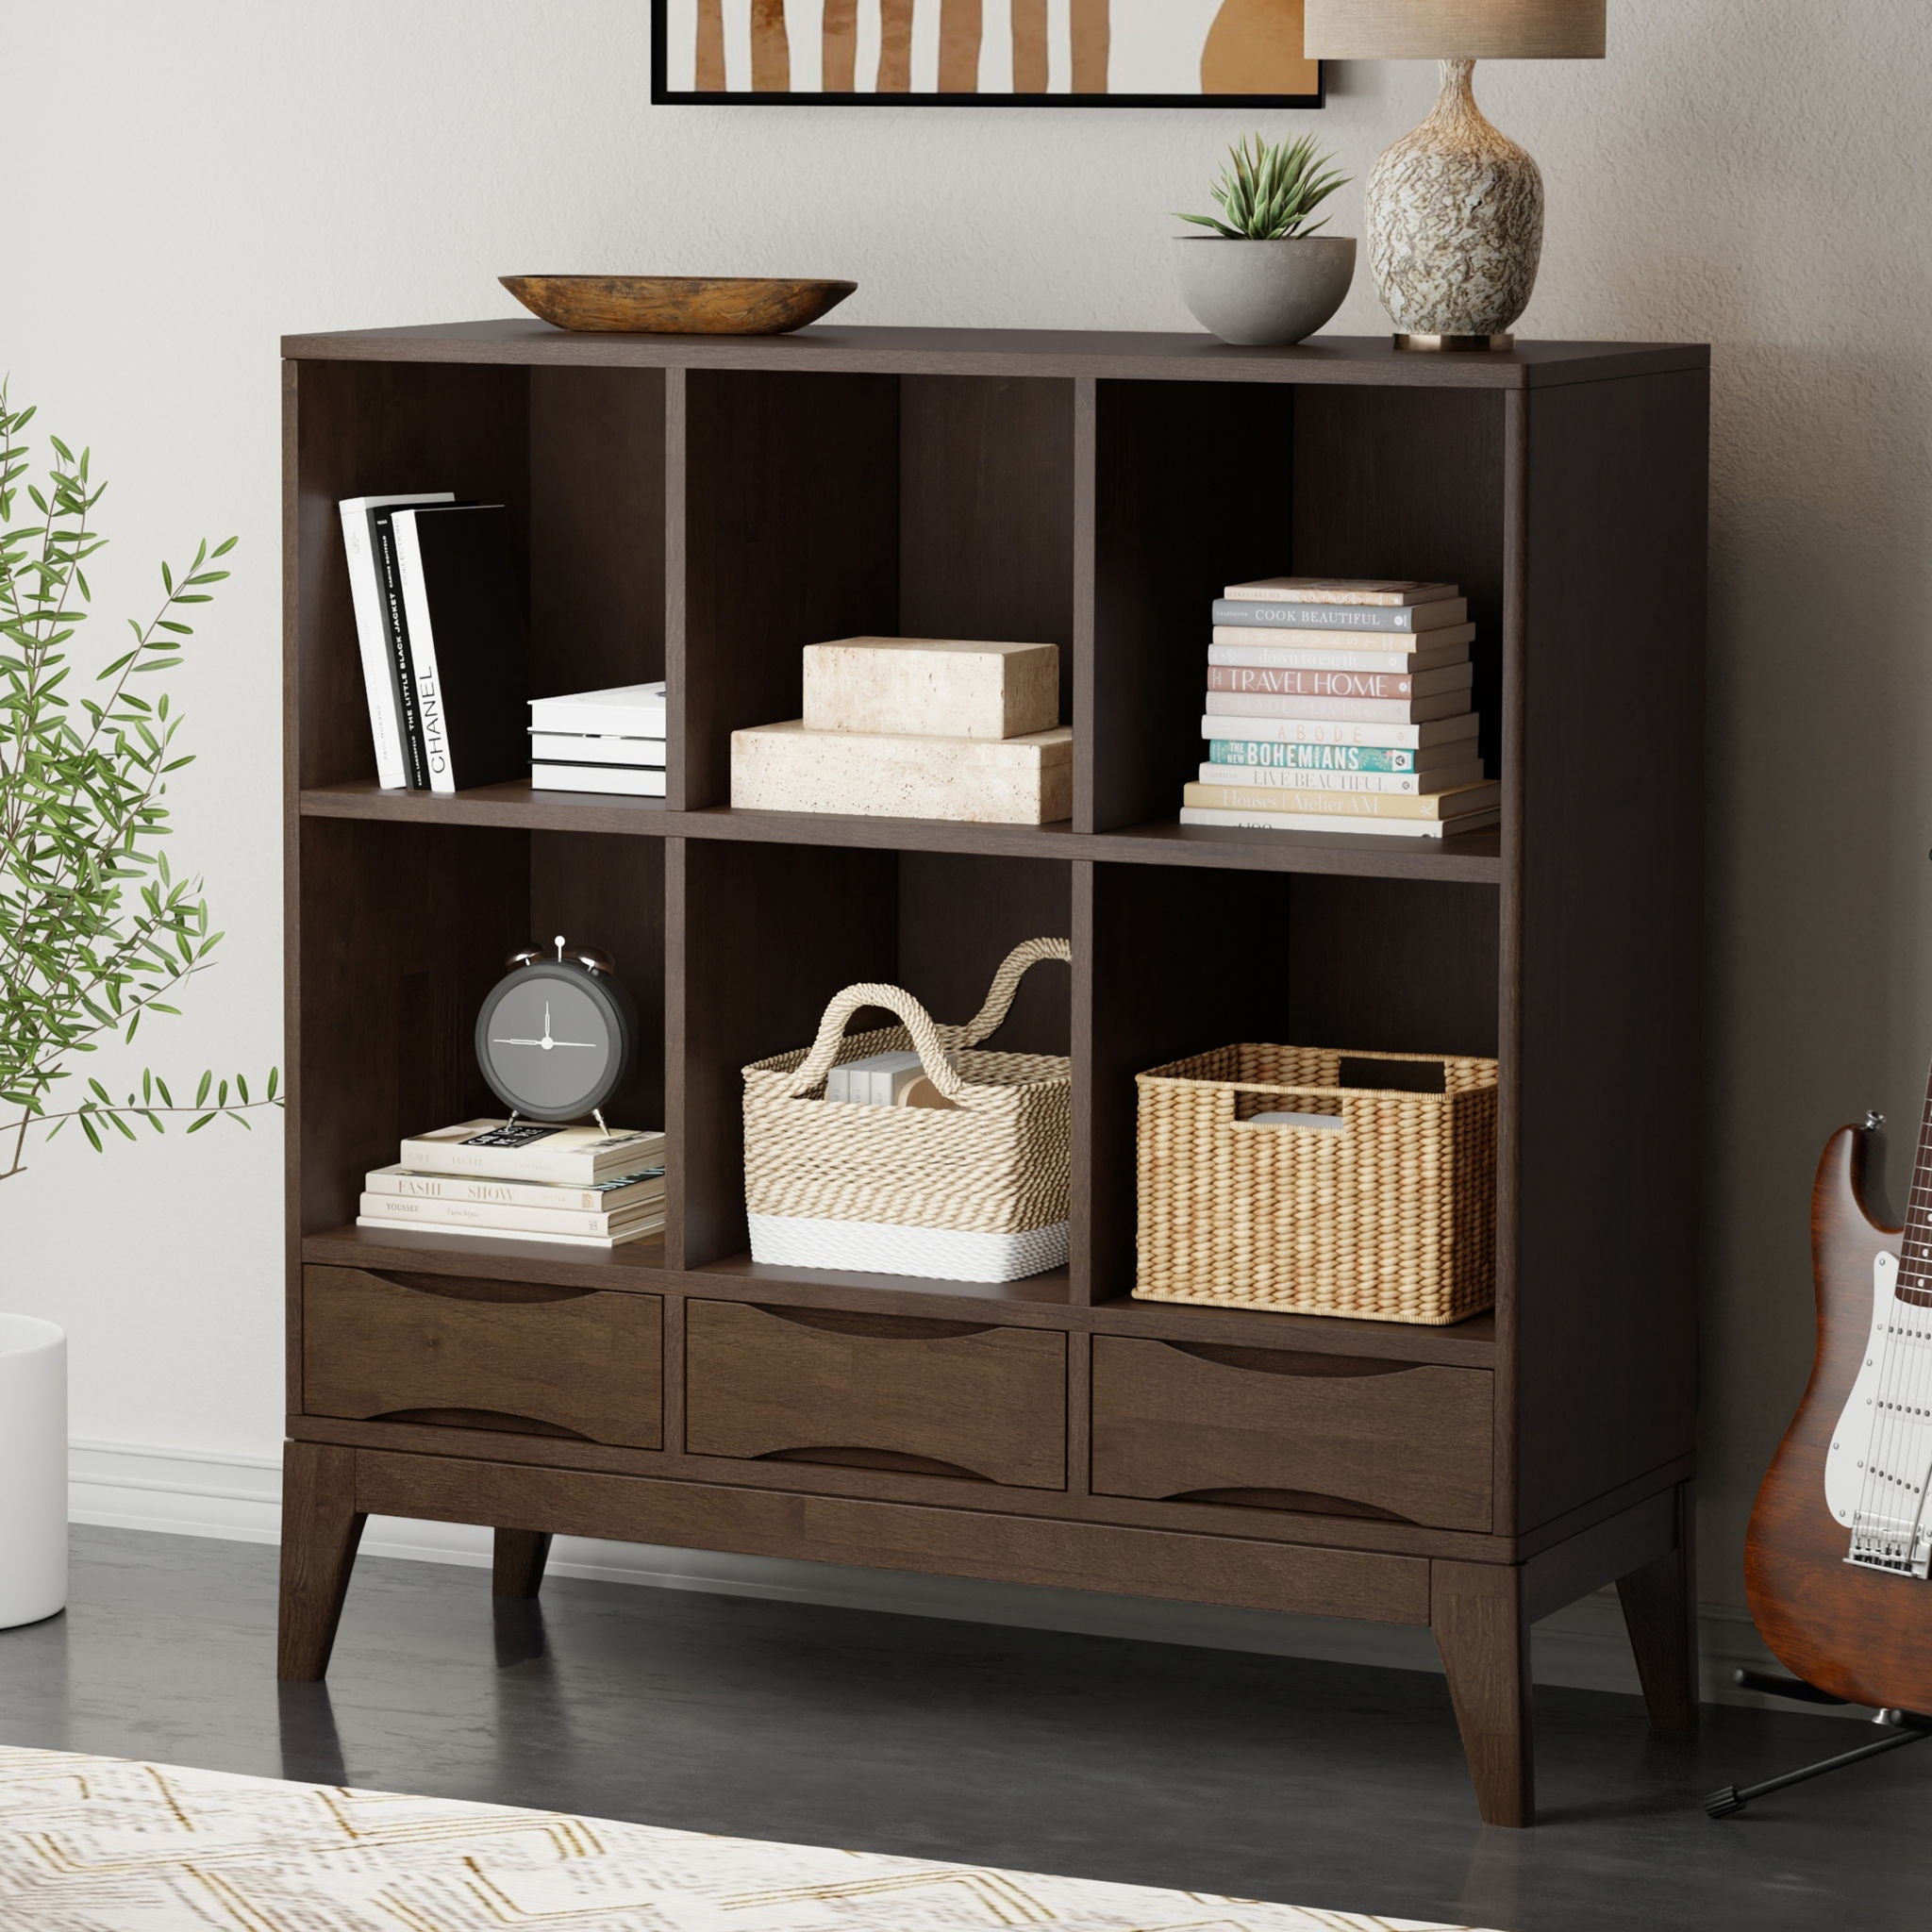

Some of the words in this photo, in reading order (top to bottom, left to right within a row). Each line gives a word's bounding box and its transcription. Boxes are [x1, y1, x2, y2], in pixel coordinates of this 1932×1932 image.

[390, 592, 401, 633] JACKET
[1255, 609, 1296, 622] COOK
[1302, 610, 1380, 625] BEAUTIFUL
[395, 635, 407, 669] BLACK
[1258, 649, 1297, 663] down
[1301, 653, 1316, 664] to
[1316, 653, 1357, 667] earth
[401, 673, 411, 707] LITTLE
[1227, 669, 1308, 693] TRAVEL
[1314, 673, 1389, 697] HOME
[407, 709, 415, 731] THE
[420, 666, 445, 774] CHANEL
[1277, 724, 1363, 743] ABODE
[1226, 755, 1245, 764] NEW
[1247, 742, 1358, 770] BOHEMIANS
[1229, 742, 1245, 753] THE
[1254, 770, 1291, 787] LIVE
[1295, 773, 1388, 791] BEAUTIFUL
[1222, 789, 1278, 808] Houses
[1293, 792, 1345, 811] Atelier
[1349, 795, 1378, 813] AM
[467, 1185, 513, 1201] SHOW
